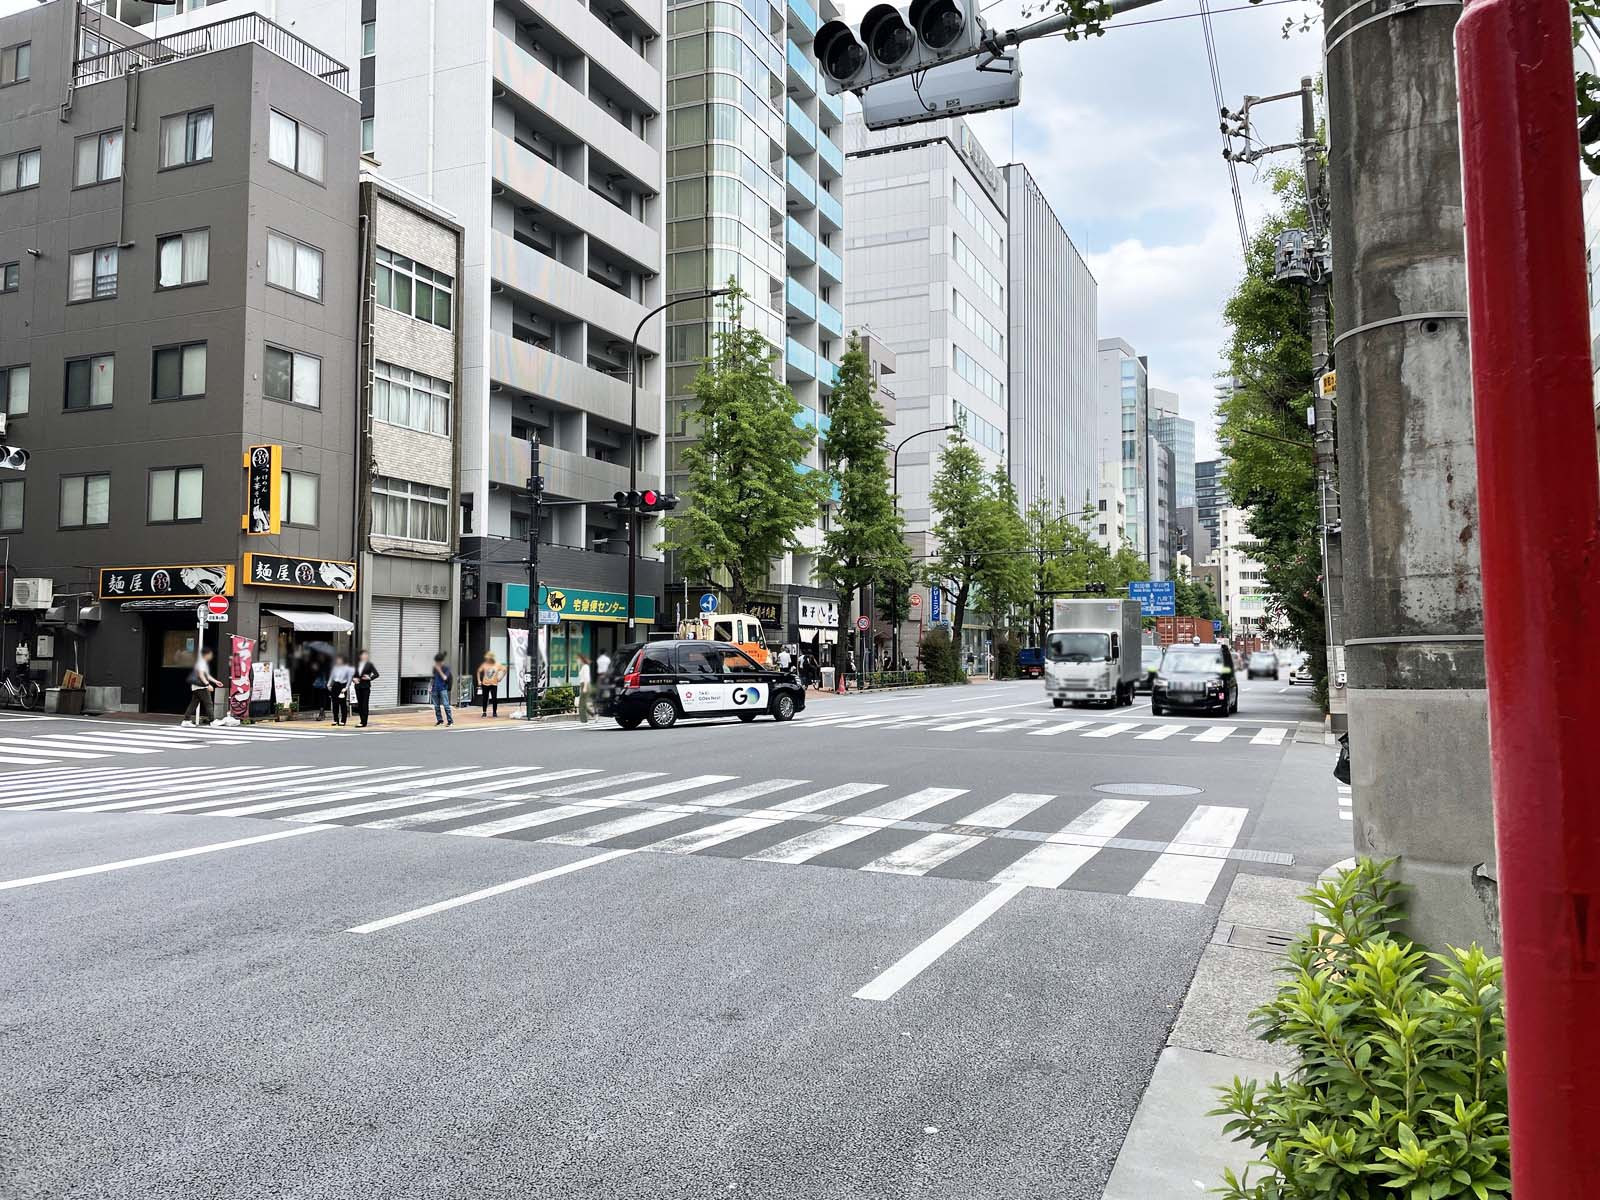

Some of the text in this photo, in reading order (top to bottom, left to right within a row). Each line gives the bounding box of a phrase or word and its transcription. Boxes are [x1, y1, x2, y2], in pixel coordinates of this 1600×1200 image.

[255, 562, 291, 581] 麺屋
[108, 573, 144, 594] 麺屋
[573, 599, 626, 614] 宅急便センター
